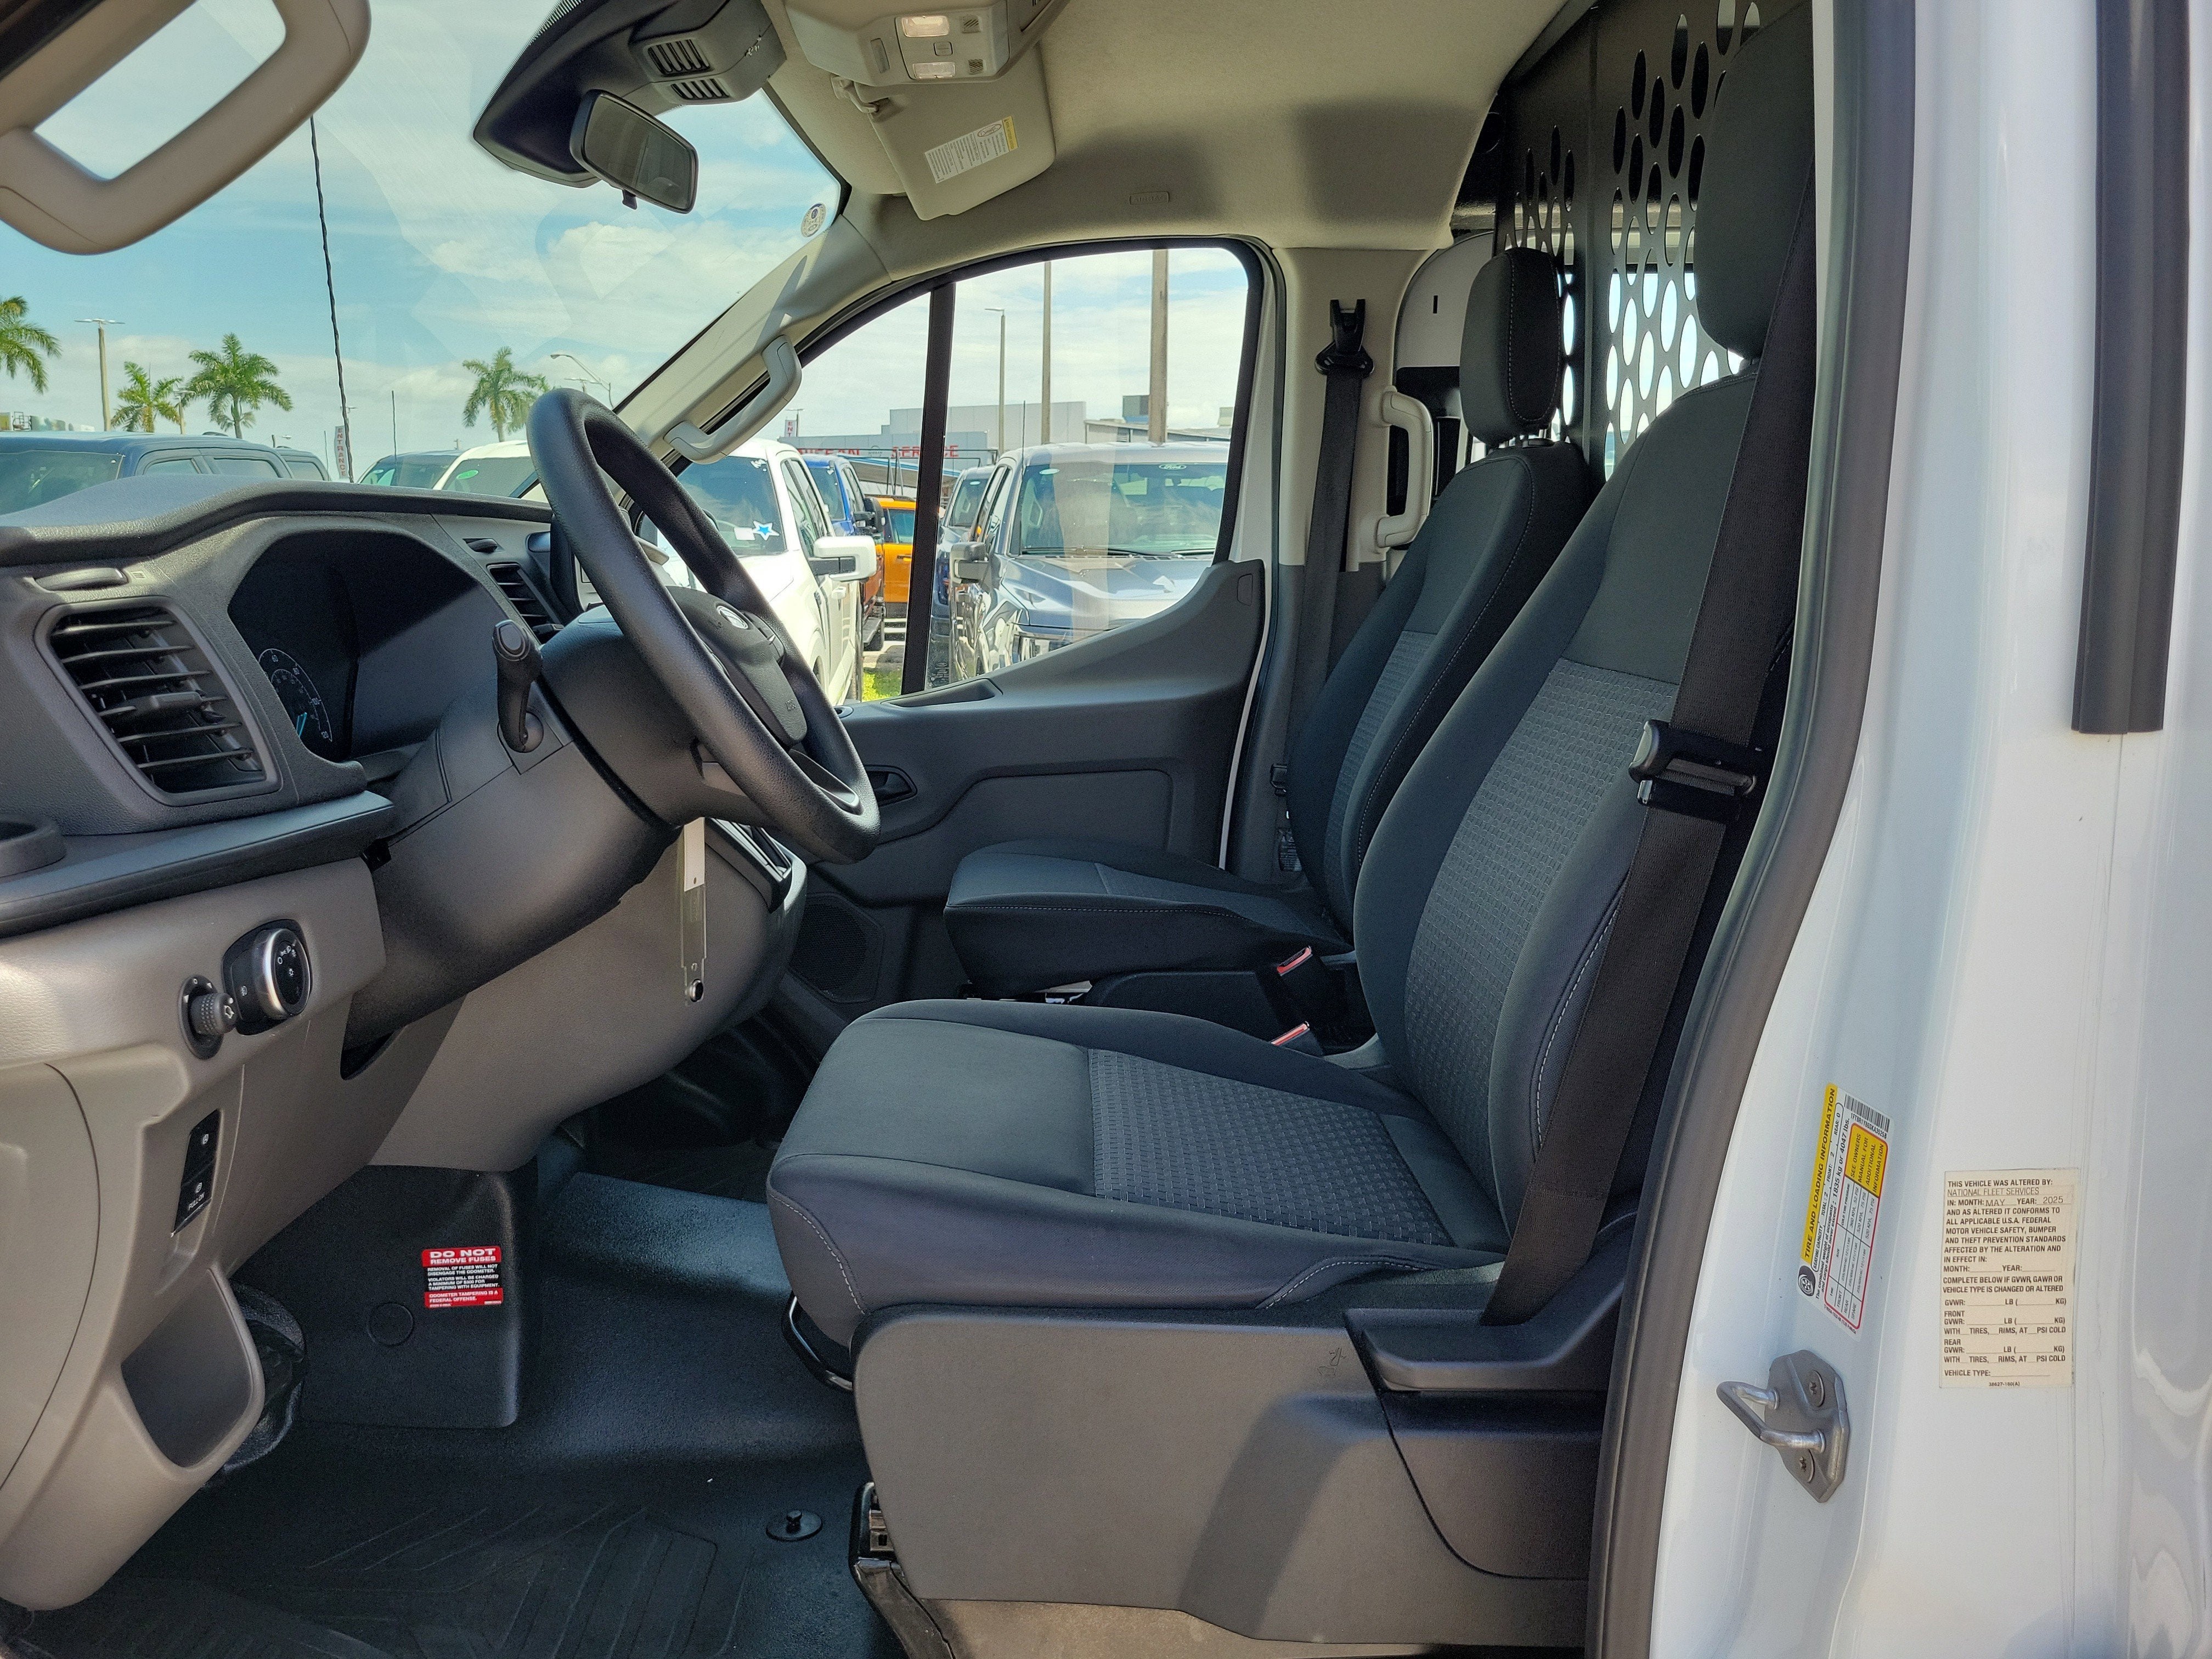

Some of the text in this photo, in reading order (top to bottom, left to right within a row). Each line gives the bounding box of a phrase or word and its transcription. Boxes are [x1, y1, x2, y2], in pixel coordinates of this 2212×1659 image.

[337, 428, 346, 476] ENTRANCE
[1838, 1155, 1843, 1165] or
[1853, 1132, 1861, 1163] OWNERS
[1804, 1234, 1813, 1260] TIRE
[1813, 1161, 1824, 1205] LOADING
[1819, 1087, 1835, 1160] INFORMATION
[1836, 1165, 1842, 1177] kg
[1858, 1152, 1866, 1183] MANUAL
[1865, 1142, 1876, 1186] ADDITIONAL
[1872, 1143, 1883, 1193] INFORMATION
[2006, 1187, 2039, 1195] SERVICES
[460, 1248, 496, 1256] NOT
